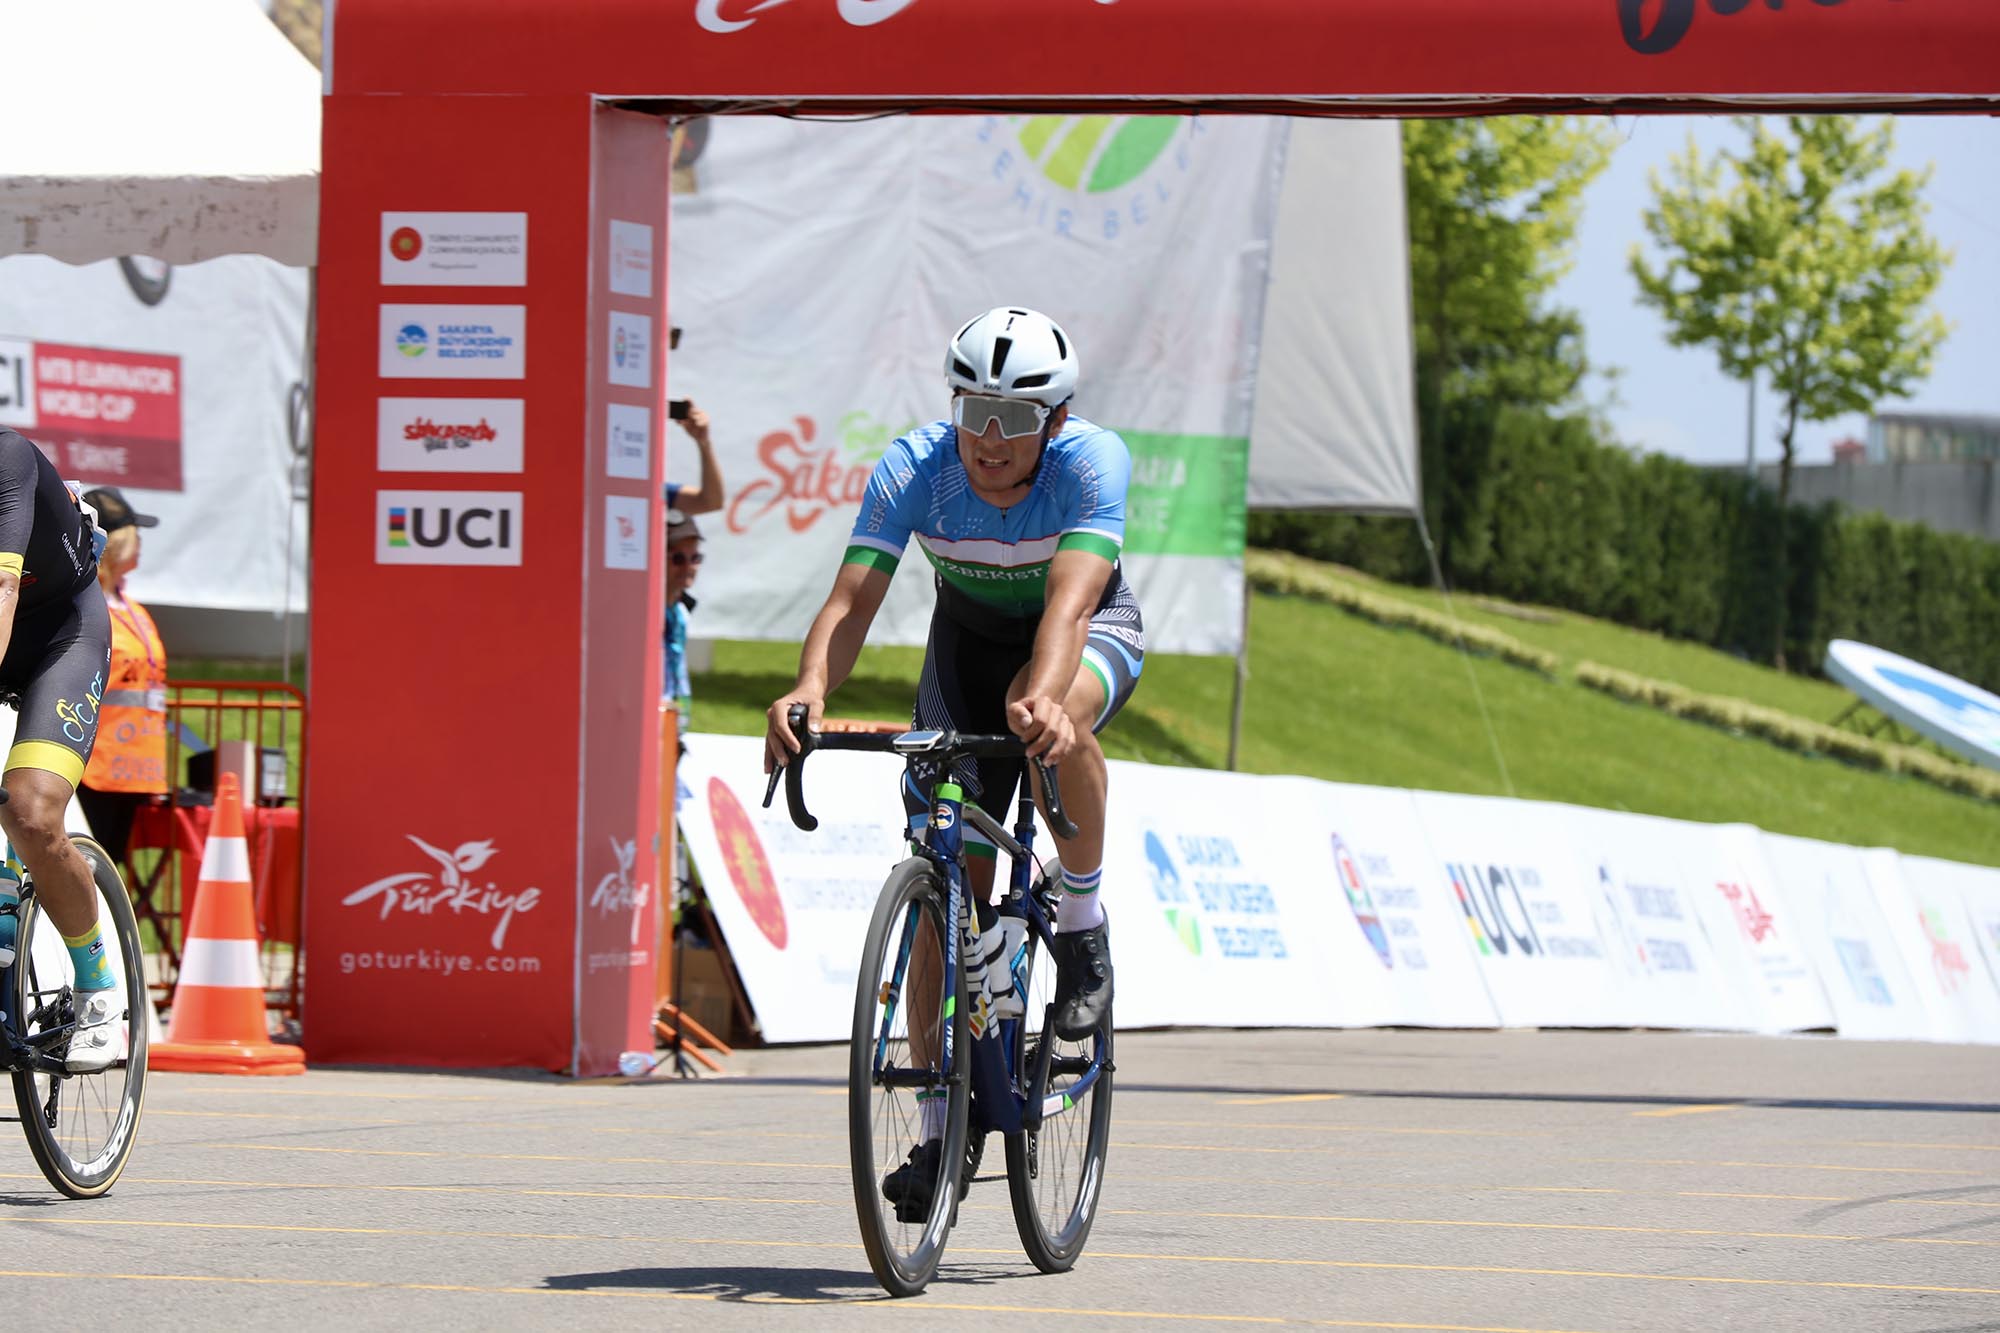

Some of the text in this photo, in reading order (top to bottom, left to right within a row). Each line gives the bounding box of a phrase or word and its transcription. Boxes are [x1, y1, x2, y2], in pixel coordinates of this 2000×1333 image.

[437, 325, 495, 334] SAKARYA
[412, 508, 510, 548] UCI
[1457, 863, 1546, 957] UCI
[340, 951, 541, 976] goturkiye.com
